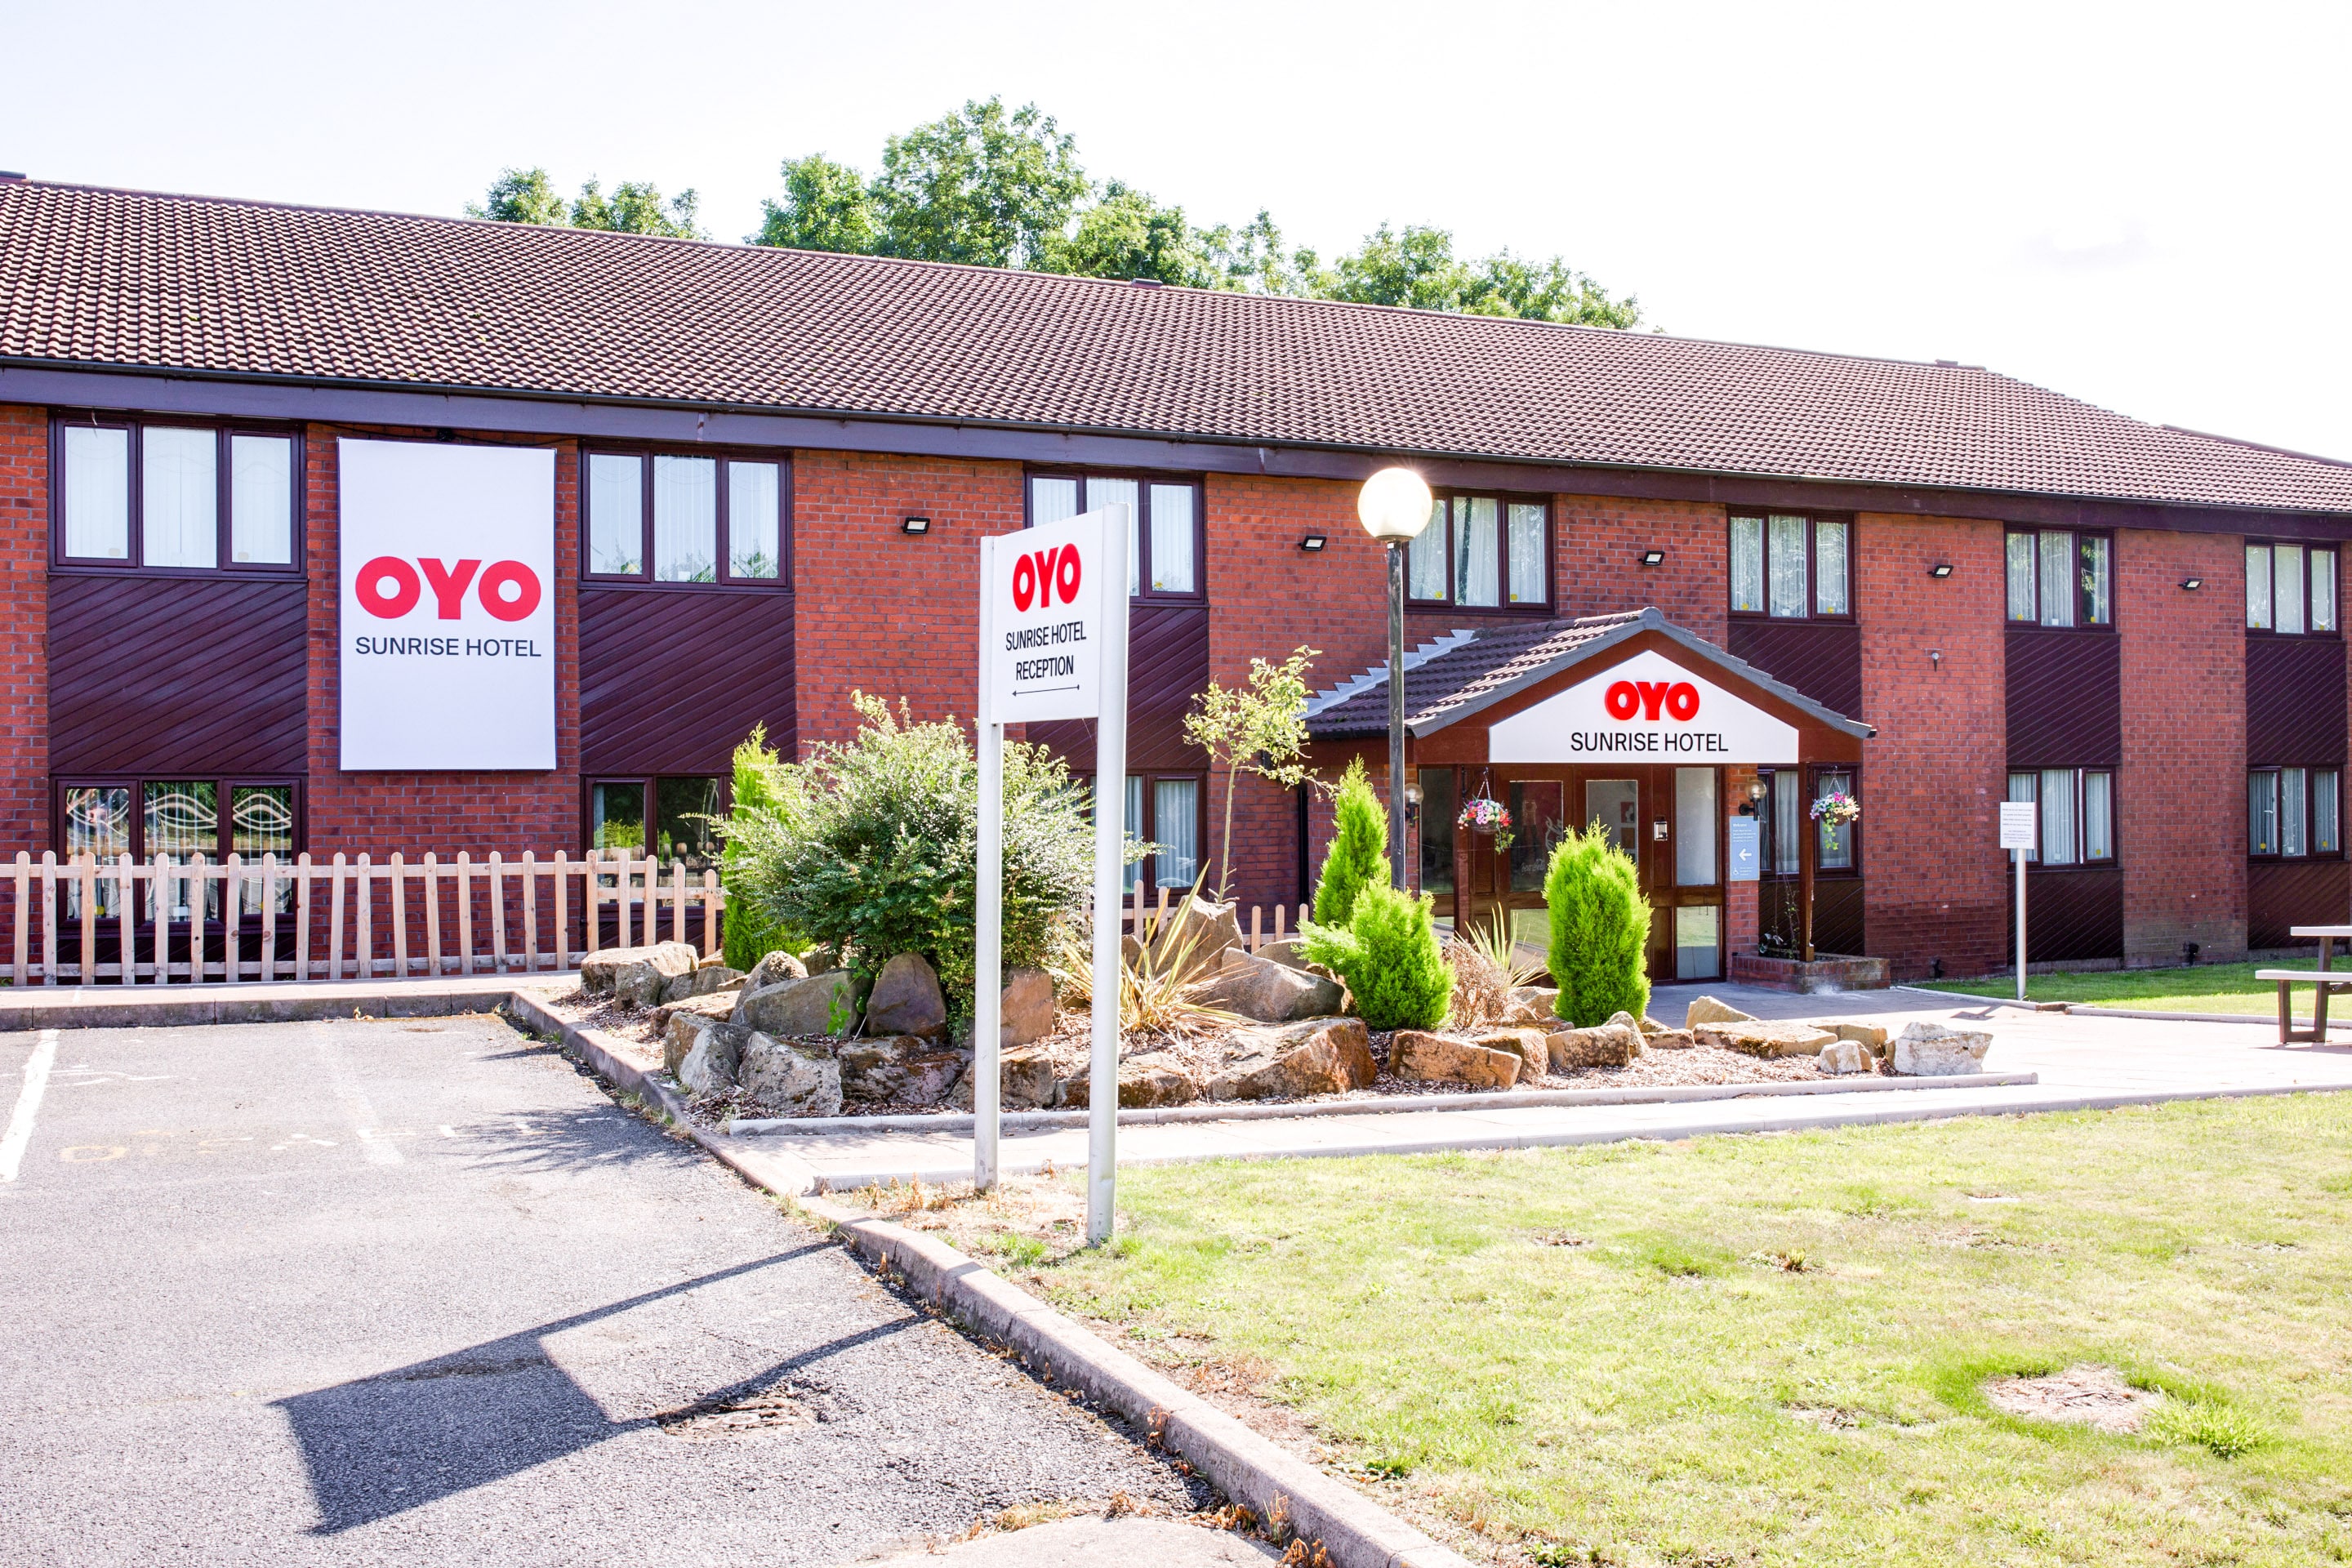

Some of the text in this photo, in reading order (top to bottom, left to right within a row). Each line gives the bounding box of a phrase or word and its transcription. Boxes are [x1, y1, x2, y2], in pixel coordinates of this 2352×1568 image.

[355, 556, 541, 621] OYO
[1012, 543, 1081, 612] OYO
[355, 637, 541, 657] SUNRISE HOTEL
[1005, 621, 1087, 651] SUNRISE HOTEL
[1016, 655, 1074, 680] RECEPTION
[1604, 680, 1699, 721] OYO
[1570, 733, 1729, 751] SUNRISE HOTEL
